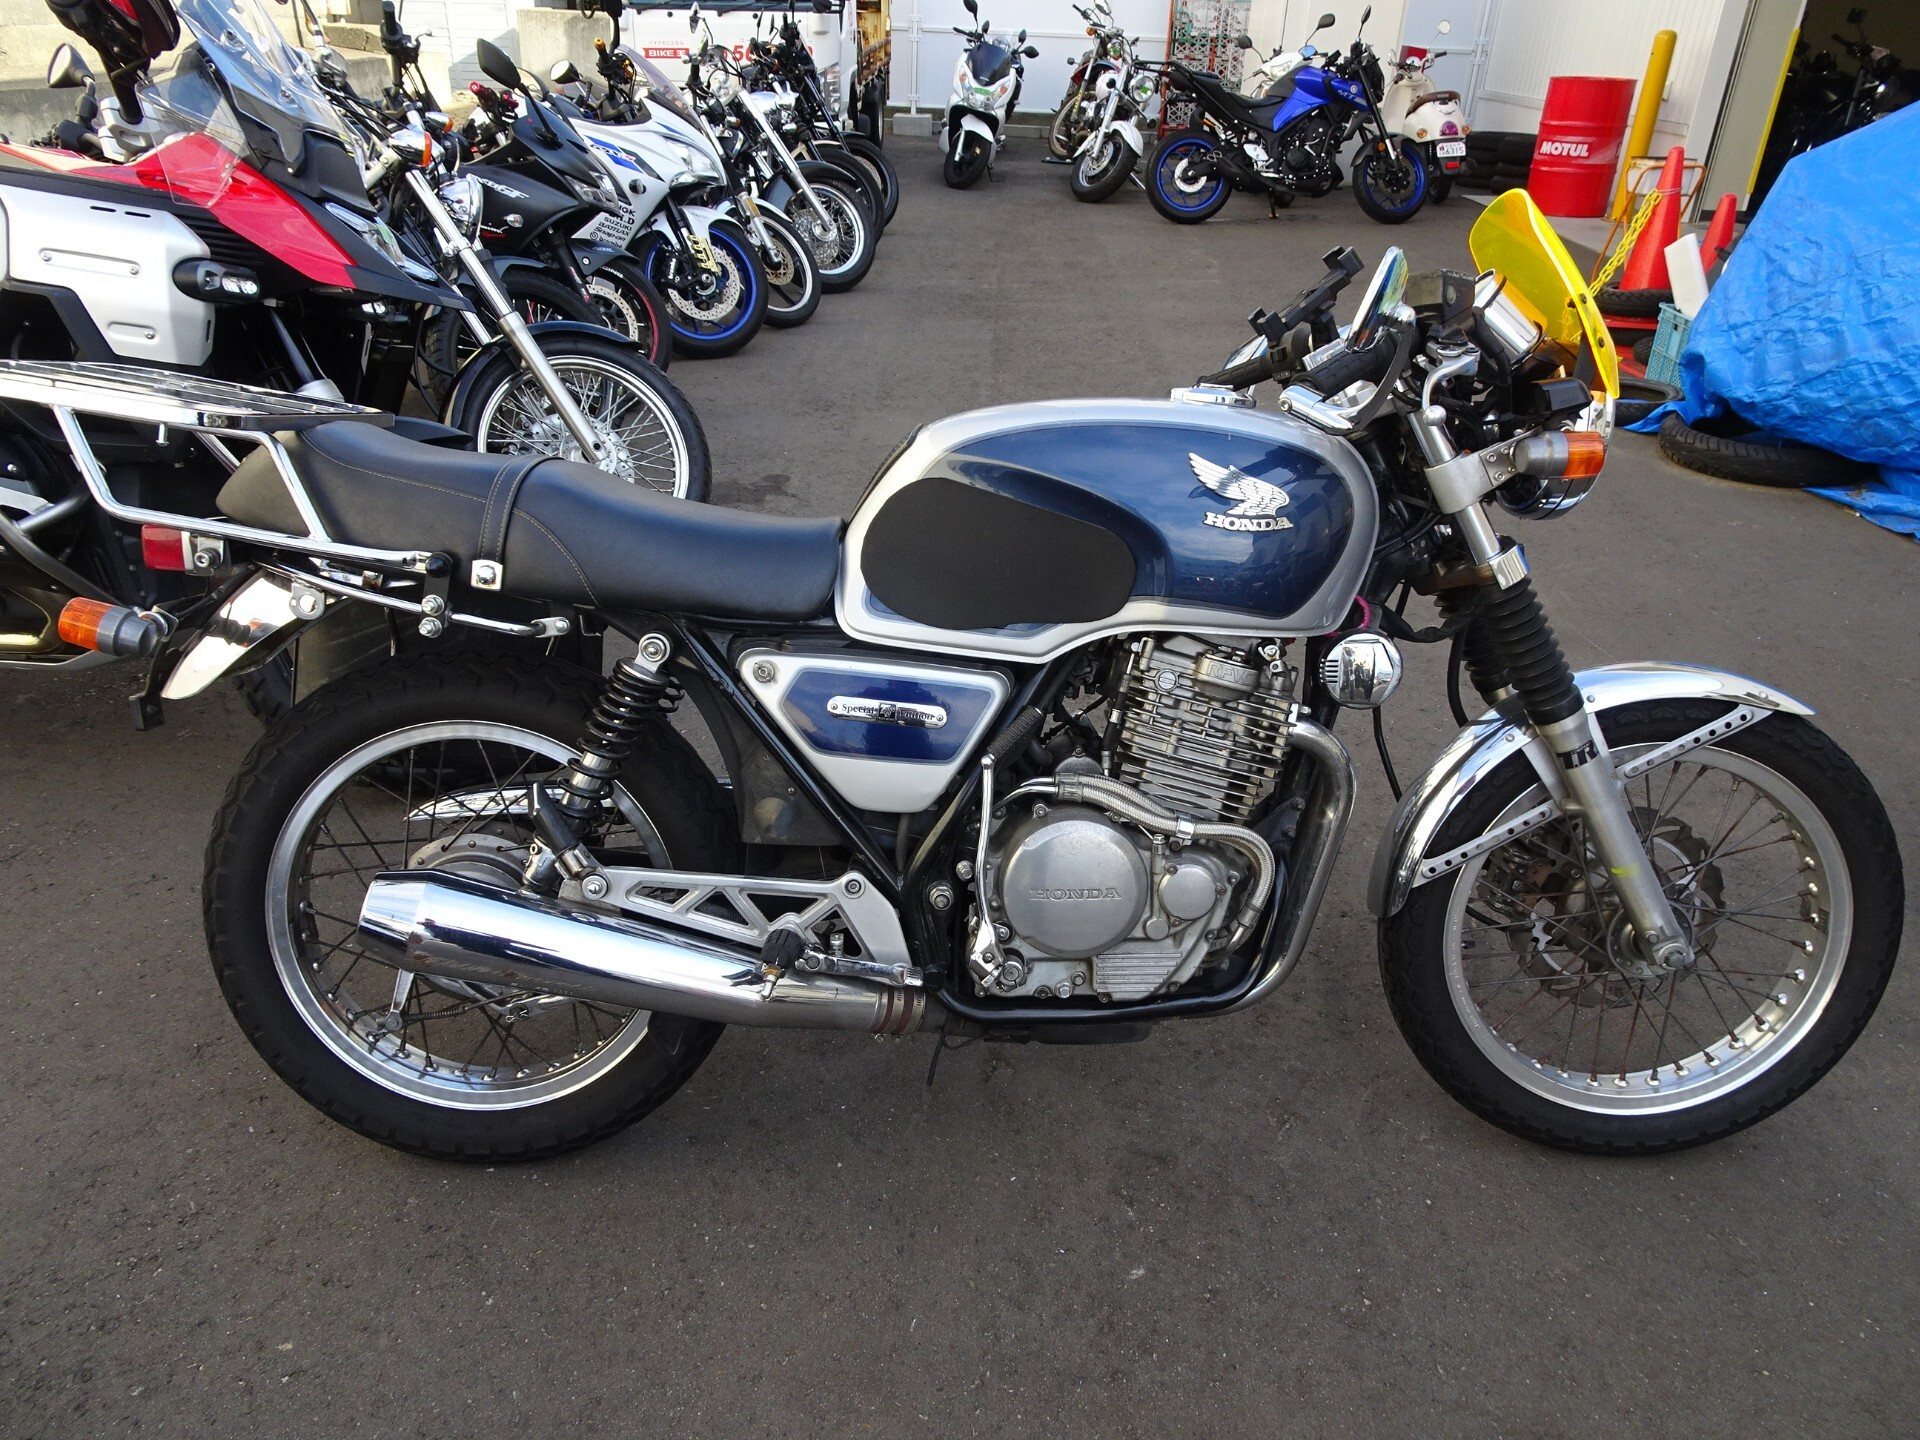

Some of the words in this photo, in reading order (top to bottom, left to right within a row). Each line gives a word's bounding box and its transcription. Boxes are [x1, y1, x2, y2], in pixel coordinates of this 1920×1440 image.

[648, 49, 674, 57] BIKE
[1539, 140, 1589, 158] MOTUL
[604, 216, 632, 231] SUZUKI
[1202, 511, 1294, 532] HONDA
[841, 703, 877, 715] Special
[1029, 887, 1122, 901] HONDA
